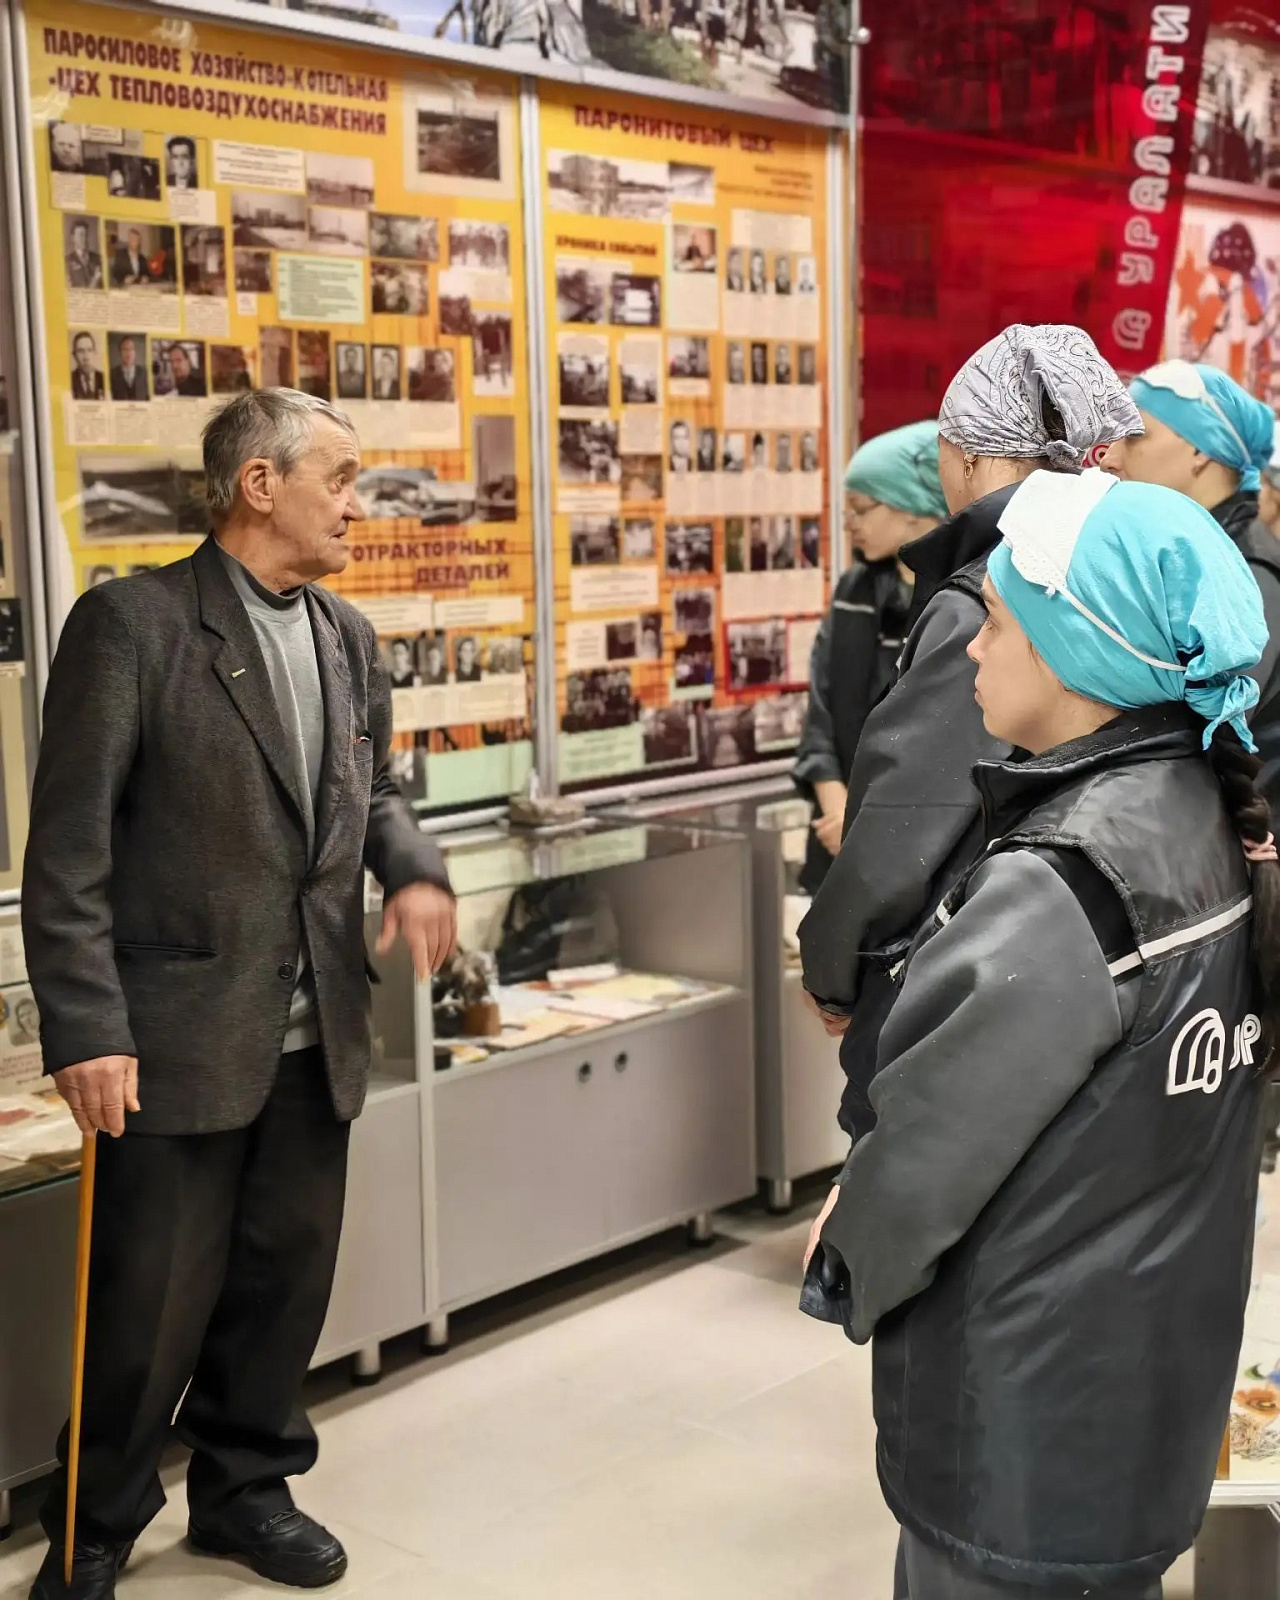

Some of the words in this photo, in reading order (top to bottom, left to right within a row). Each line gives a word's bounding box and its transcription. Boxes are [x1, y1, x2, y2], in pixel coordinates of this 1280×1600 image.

[44, 27, 181, 72] ПАРОСИЛОВОЕ
[109, 74, 387, 135] ТЕПЛОВОЗДУХОСНАБЖЕНИЯ
[574, 105, 732, 148] ПАРОНИТОВЫЙ
[352, 538, 507, 562] ОТРАКТОРНЫХ
